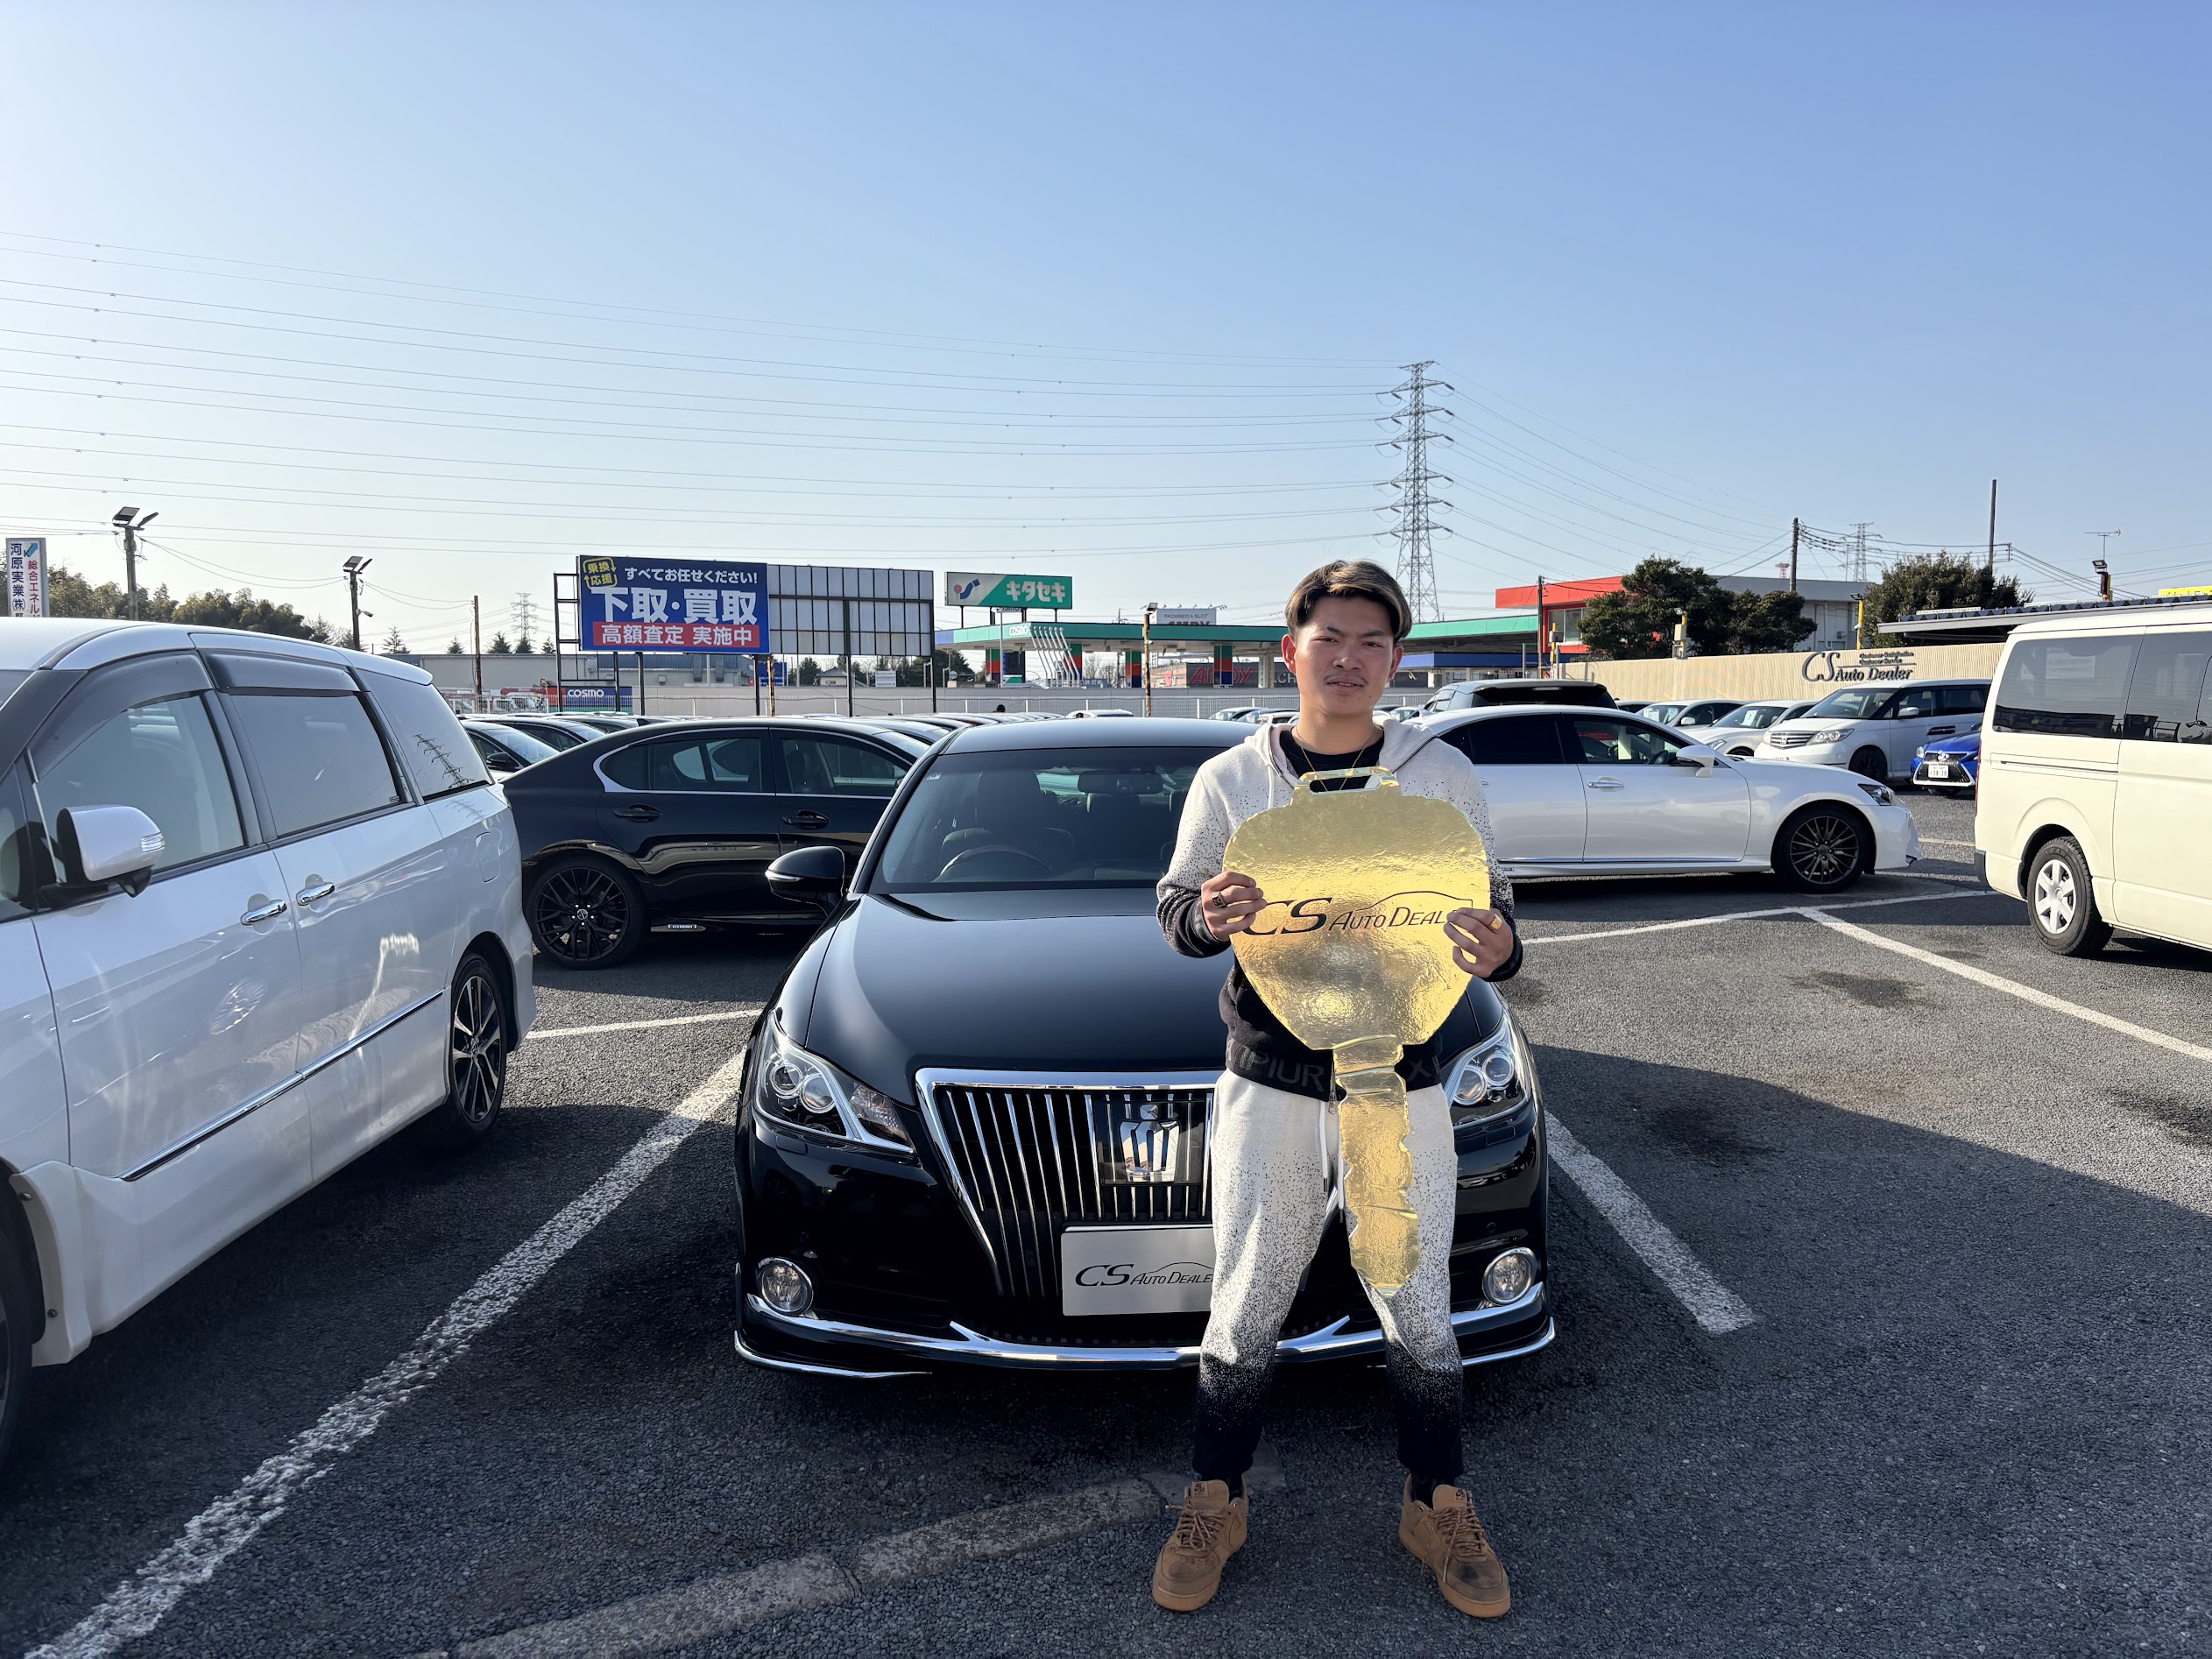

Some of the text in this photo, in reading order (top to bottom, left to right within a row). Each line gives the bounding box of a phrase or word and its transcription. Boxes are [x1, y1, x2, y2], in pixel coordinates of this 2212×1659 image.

[625, 567, 758, 584] すべてお任せください!
[28, 561, 40, 617] 総合エネル
[1006, 581, 1065, 603] キタセキ
[590, 587, 758, 625] 下取・買取
[601, 625, 752, 646] 高額査定 実施中
[1802, 652, 1913, 681] CS Auto Dealer
[1243, 897, 1332, 936] CS
[1388, 907, 1450, 928] DEAL
[1075, 1264, 1134, 1287] CS
[1167, 1271, 1214, 1284] DEALE
